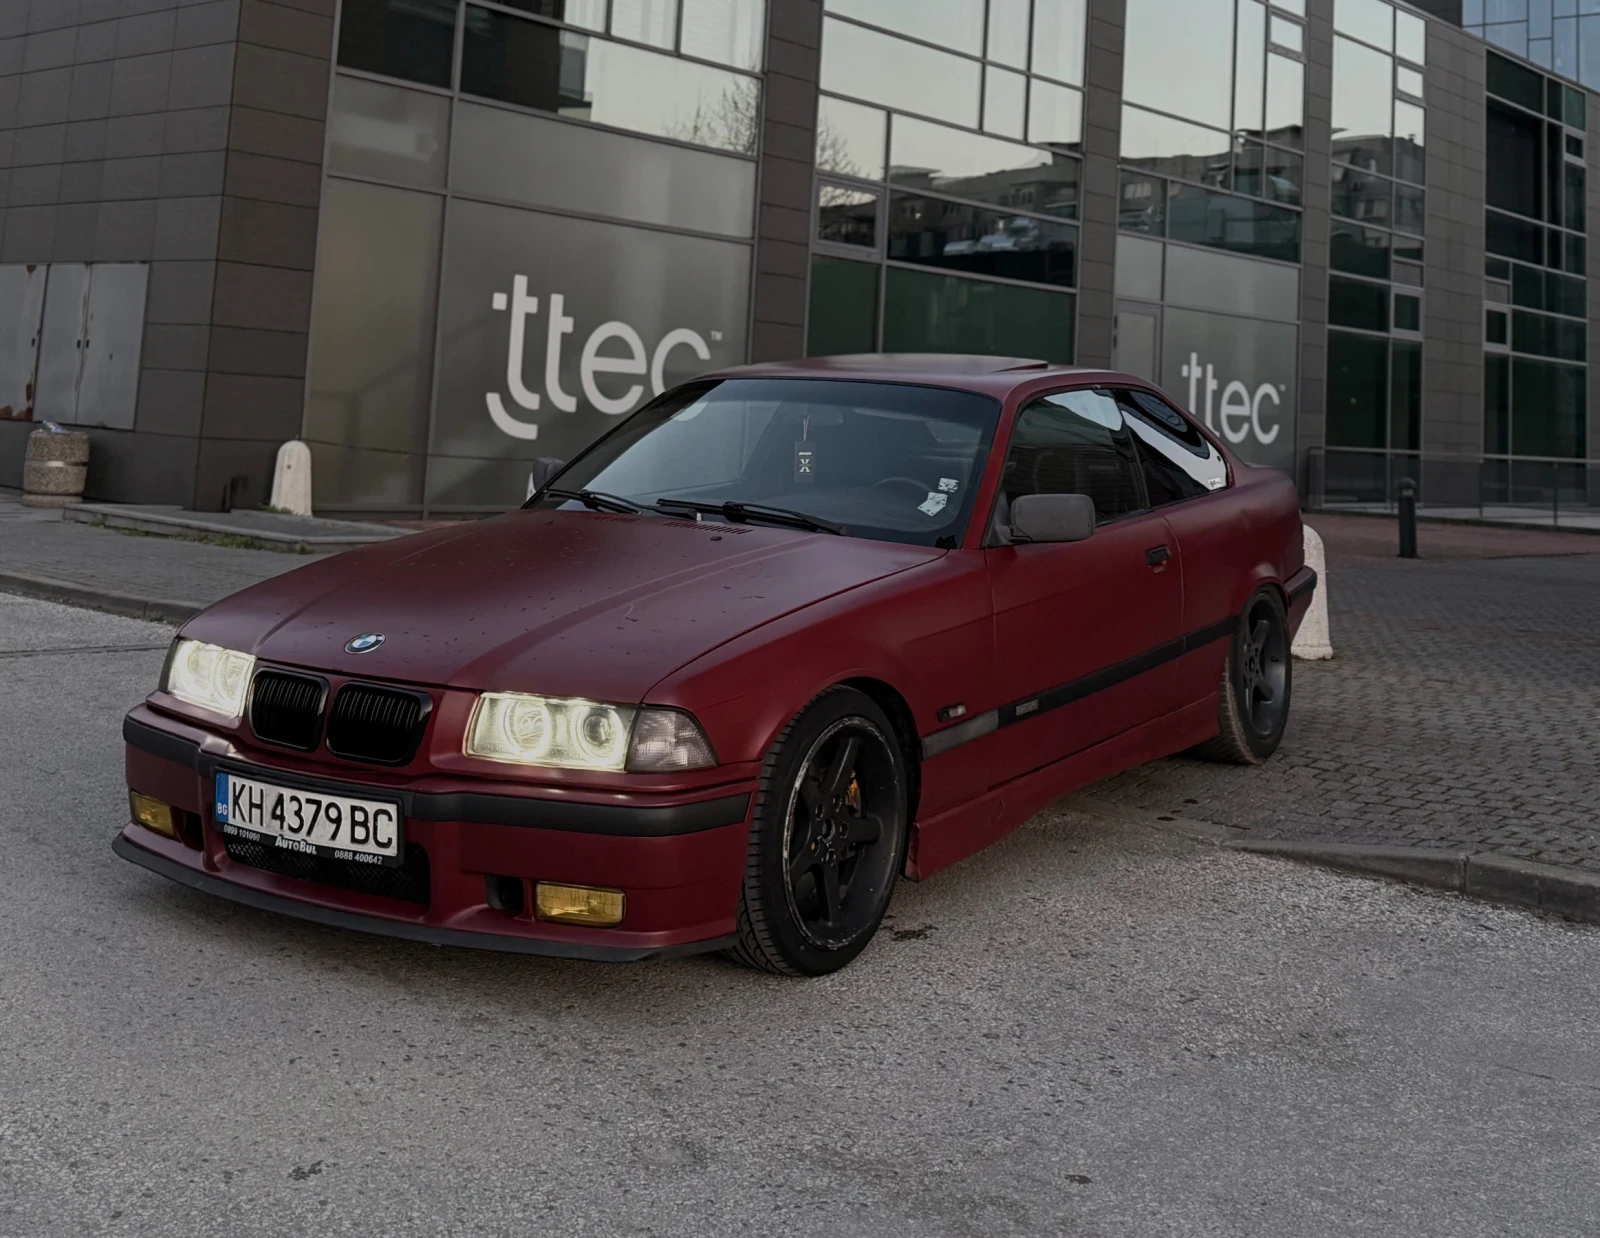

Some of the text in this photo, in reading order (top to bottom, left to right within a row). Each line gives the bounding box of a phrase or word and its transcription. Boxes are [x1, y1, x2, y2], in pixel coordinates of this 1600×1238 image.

[486, 274, 711, 440] ttec
[1182, 352, 1280, 445] ttec
[217, 802, 228, 816] BG
[232, 781, 393, 849] KH 4379 BC
[334, 850, 383, 865] 0888 400642
